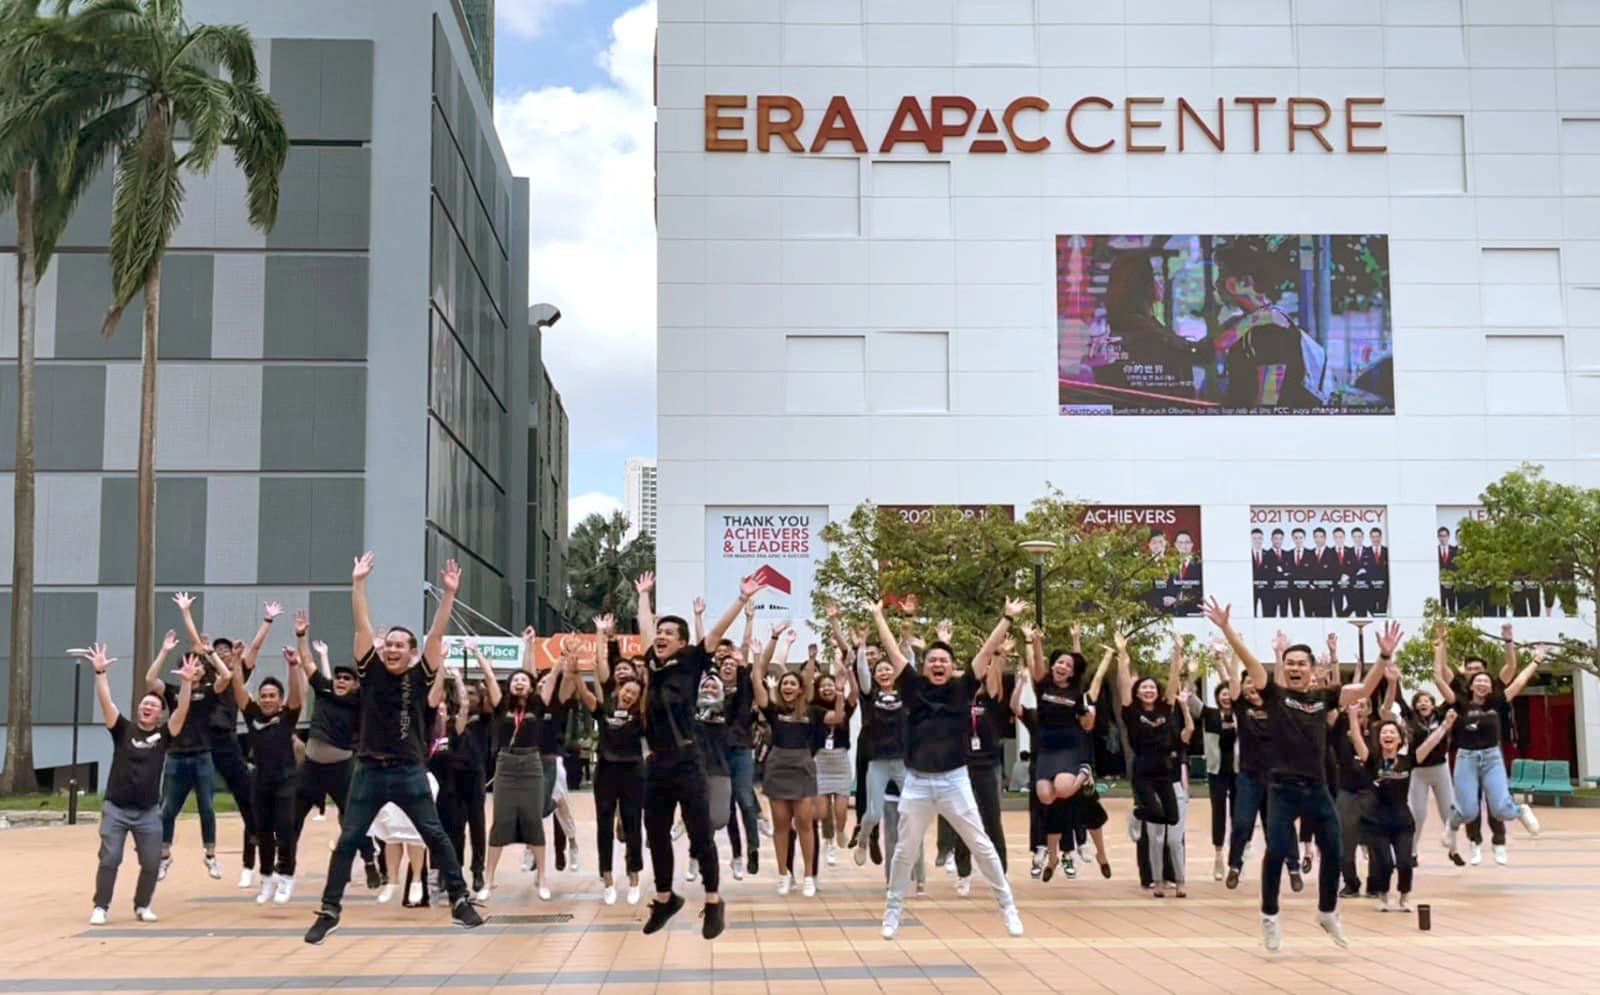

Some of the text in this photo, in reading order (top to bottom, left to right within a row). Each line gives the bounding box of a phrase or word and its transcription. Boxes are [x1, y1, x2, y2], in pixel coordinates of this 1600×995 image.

[704, 95, 1388, 153] ERA APAC CENTRE
[723, 515, 810, 527] THANK YOU
[1083, 509, 1176, 524] ACHIEVERS
[1250, 509, 1384, 523] 2021 TOP AGENCY
[723, 528, 810, 540] ACHIEVERS
[723, 540, 810, 553] & LEADERS
[484, 645, 516, 657] Place
